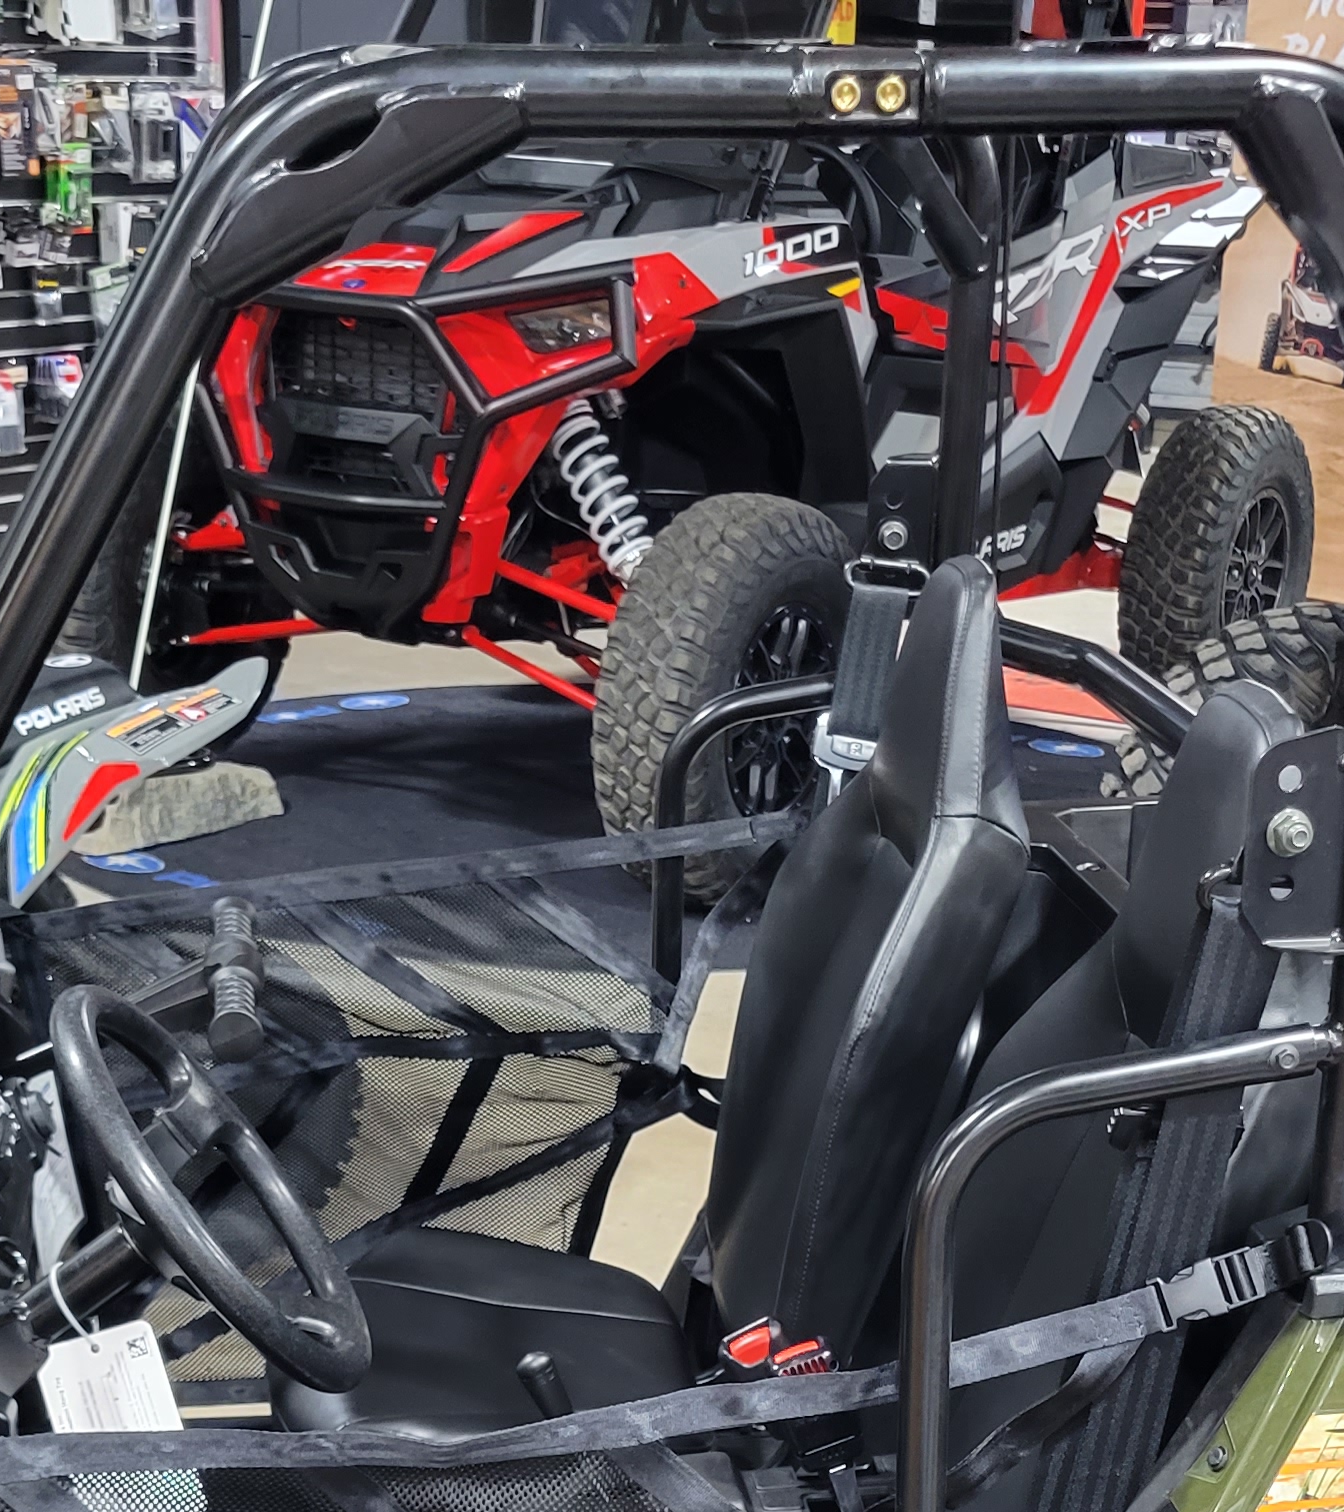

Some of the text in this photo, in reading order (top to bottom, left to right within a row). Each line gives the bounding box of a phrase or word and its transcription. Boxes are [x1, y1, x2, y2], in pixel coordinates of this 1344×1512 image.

[1120, 203, 1172, 238] XP
[742, 225, 840, 278] 1000
[975, 524, 1027, 560] ARIS
[13, 685, 106, 737] POLARIS
